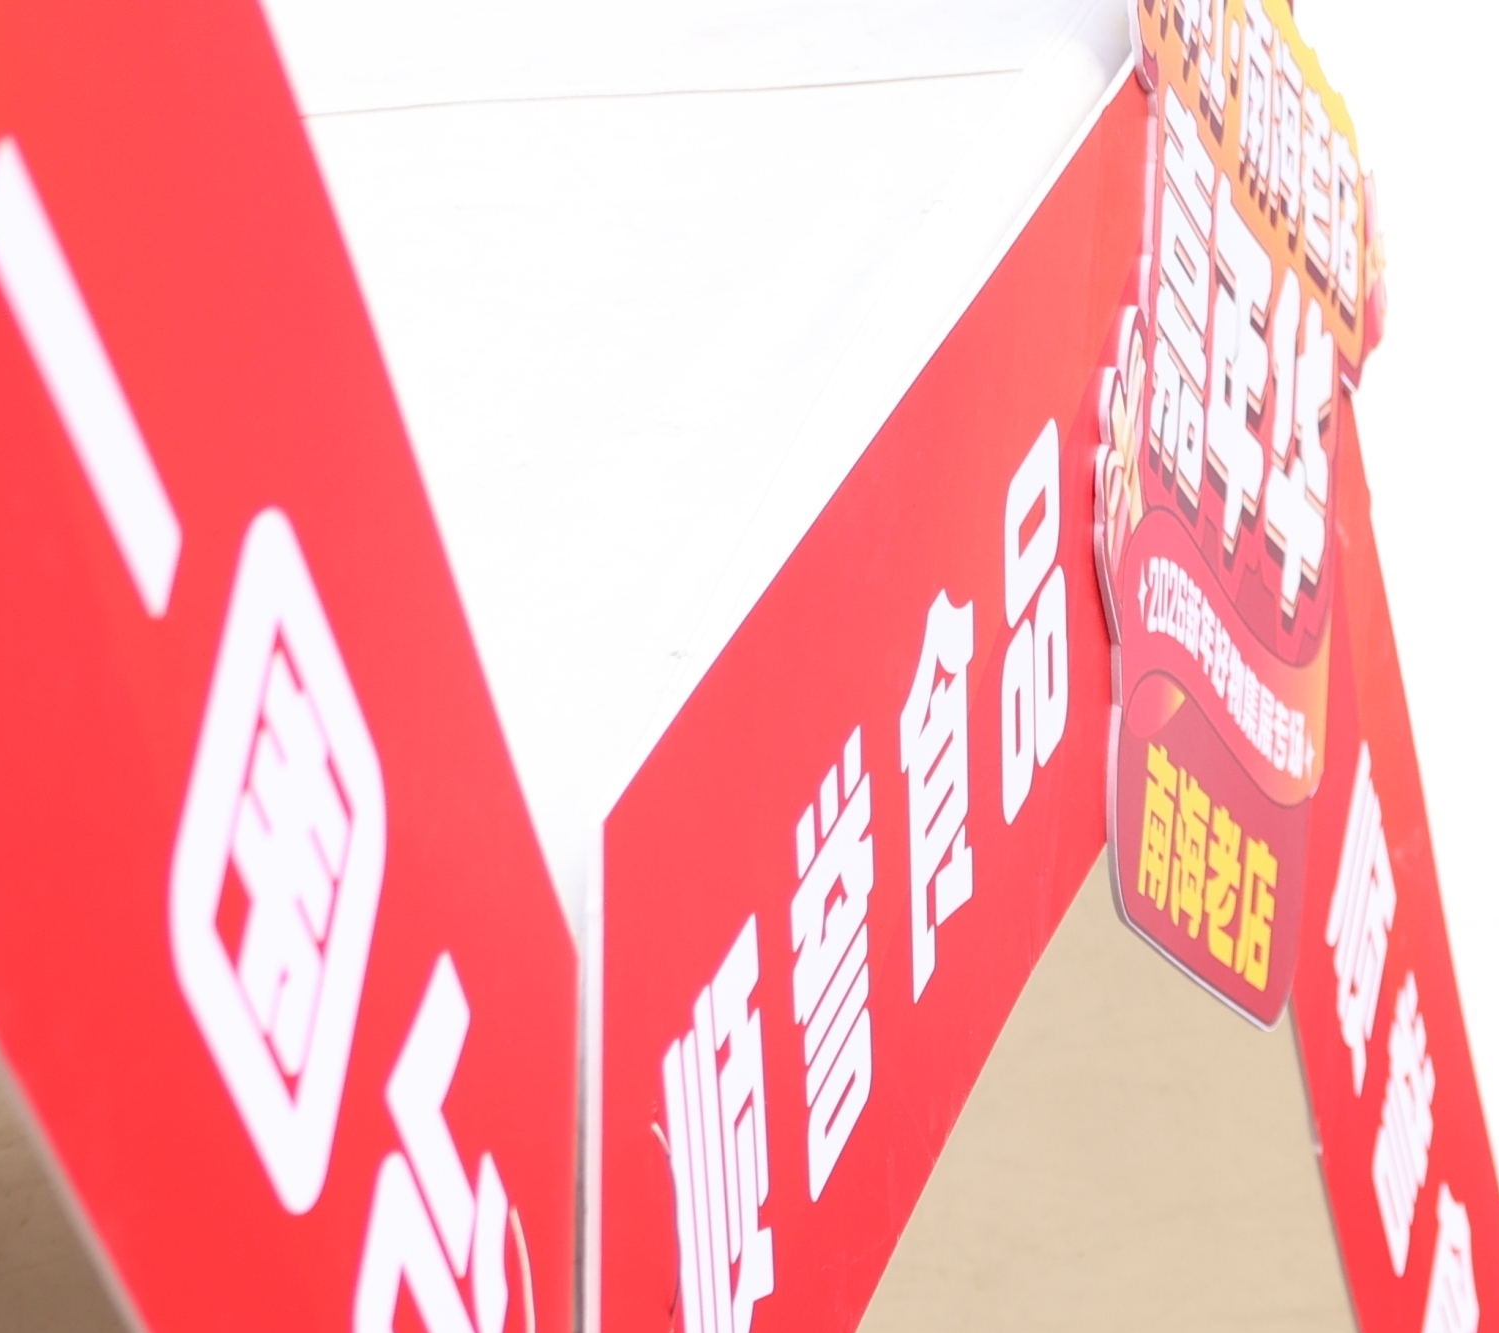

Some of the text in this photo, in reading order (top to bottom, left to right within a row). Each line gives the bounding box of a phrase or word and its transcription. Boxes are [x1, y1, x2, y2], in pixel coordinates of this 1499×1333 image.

[1149, 84, 1334, 602] 嘉年华
[1138, 742, 1279, 991] 南海老店
